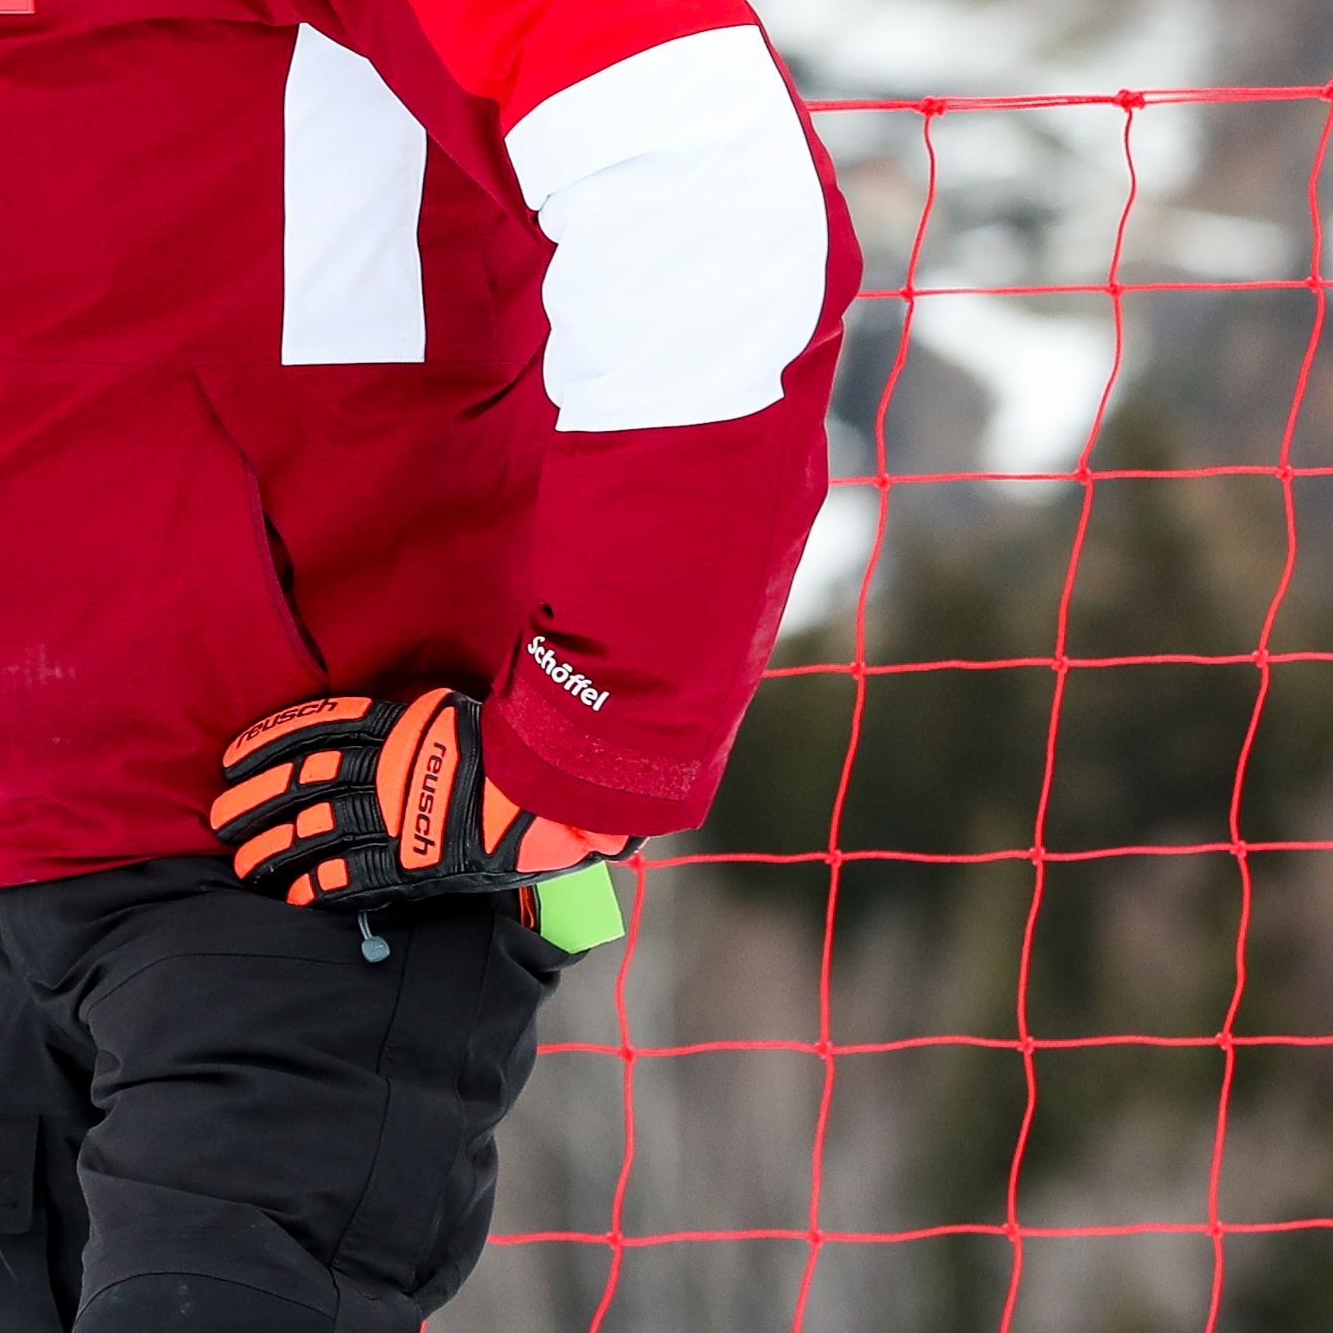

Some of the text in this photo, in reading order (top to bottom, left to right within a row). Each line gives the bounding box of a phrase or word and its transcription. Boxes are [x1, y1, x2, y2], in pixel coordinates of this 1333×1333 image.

[527, 636, 610, 712] Schöffel
[235, 697, 340, 749] reusch
[413, 740, 447, 857] reusch
